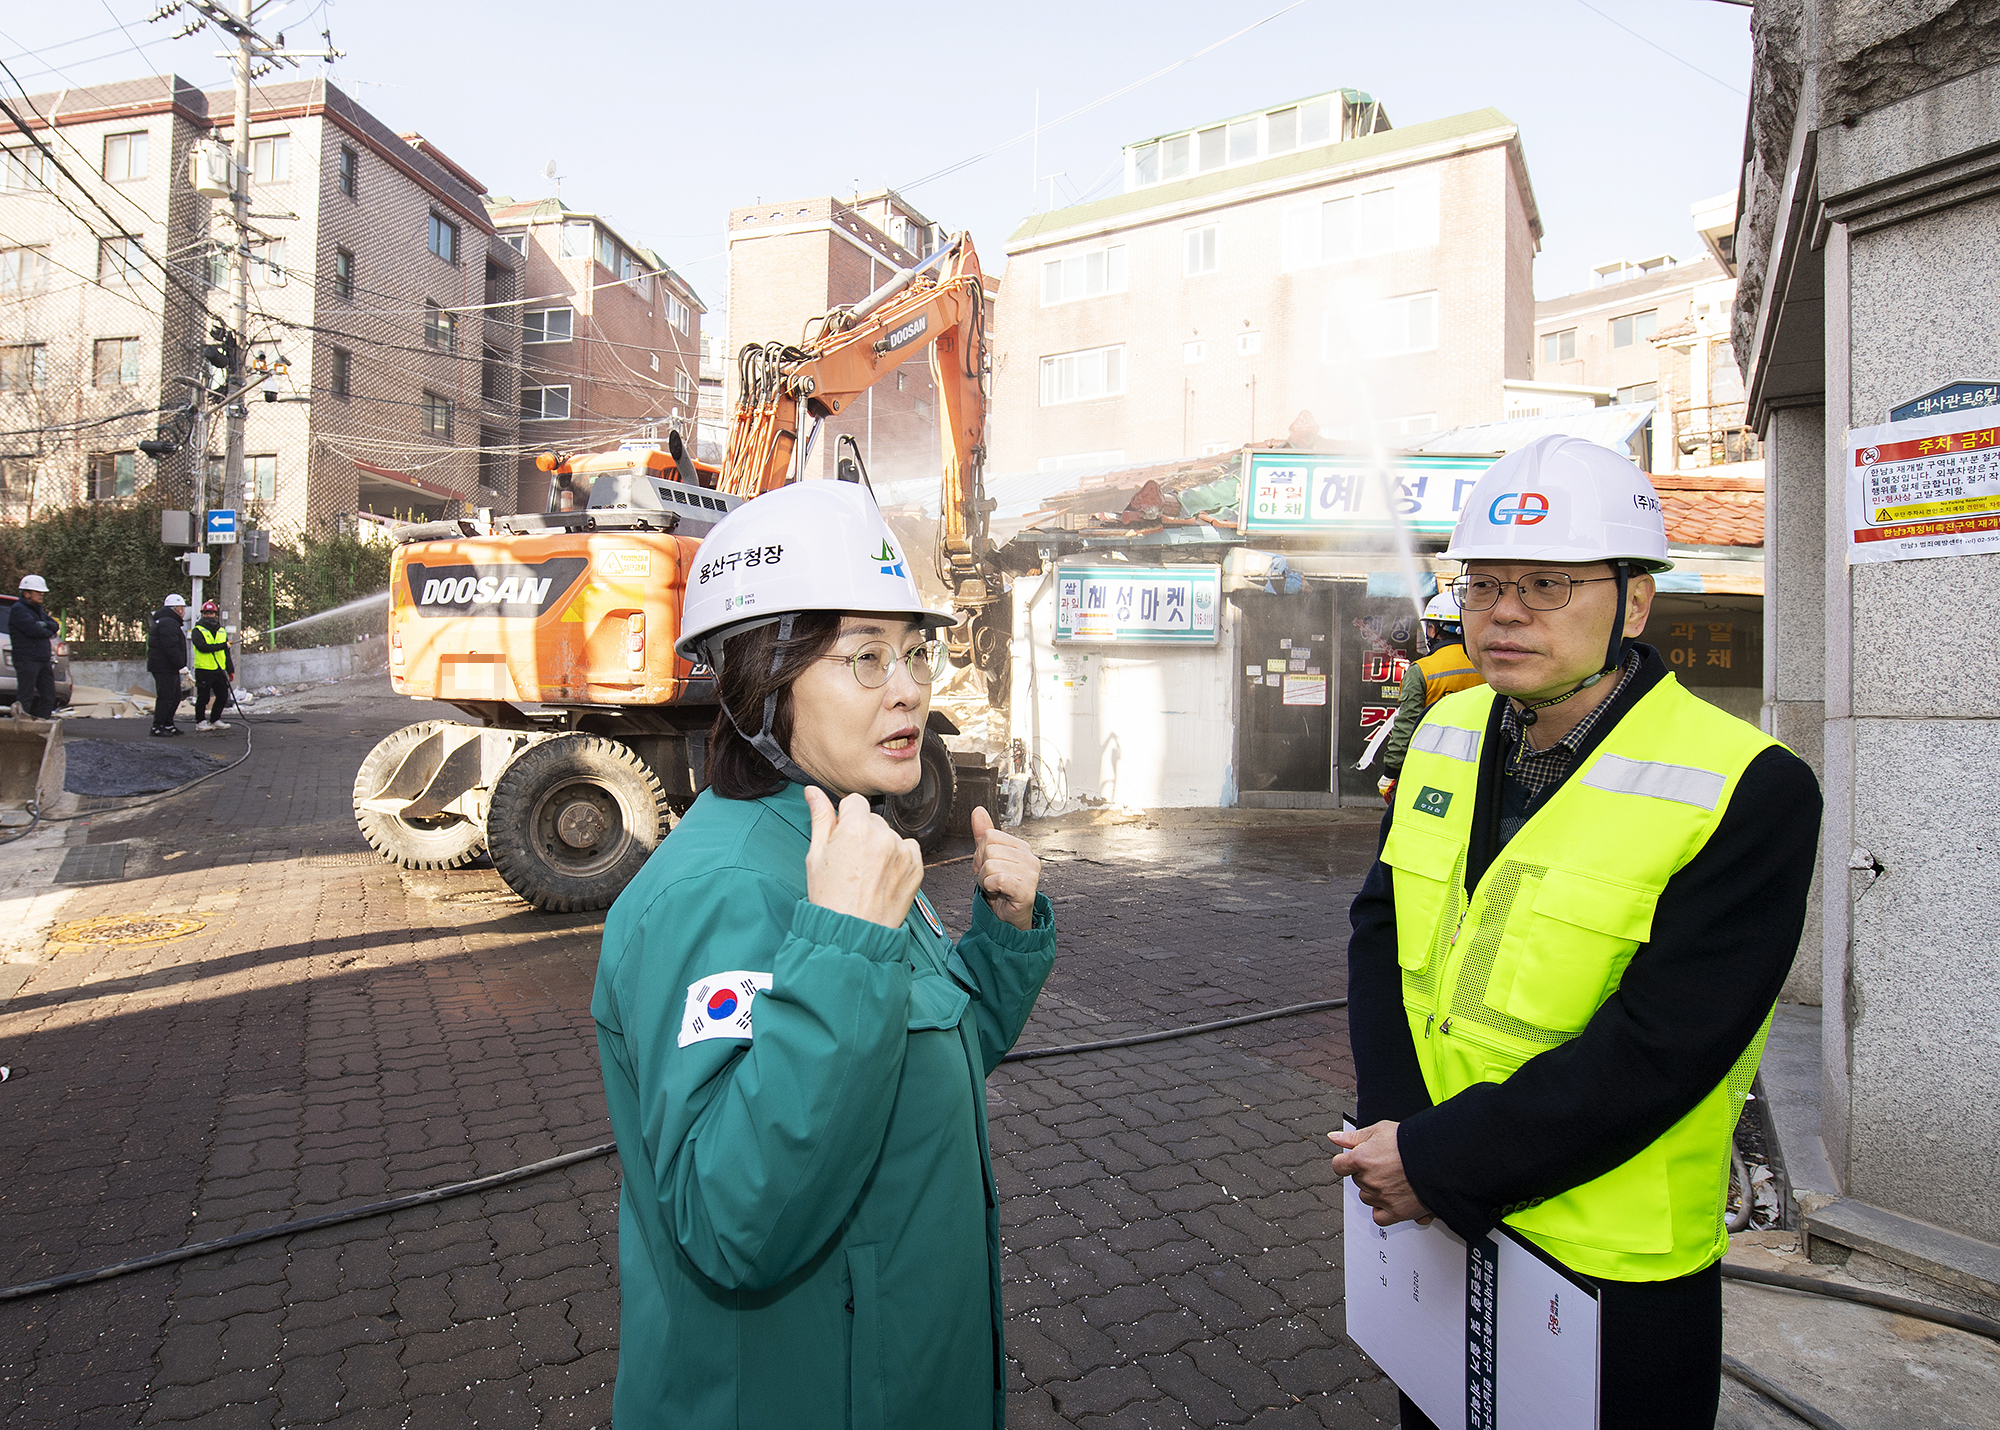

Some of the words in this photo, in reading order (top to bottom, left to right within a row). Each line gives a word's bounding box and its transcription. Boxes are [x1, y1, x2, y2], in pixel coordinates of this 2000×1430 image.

[890, 316, 926, 348] DOOSAN
[1917, 386, 1998, 412] 대사관로6길
[1918, 436, 1954, 455] 주차
[1960, 429, 1995, 450] 금지
[1269, 471, 1297, 484] 쌀
[1870, 467, 1894, 478] 한남3
[1896, 462, 1924, 474] 재개발
[1926, 457, 1956, 470] 구역내
[1881, 471, 1932, 484] 예정입니다.
[1936, 463, 1987, 478] 외부차량은
[1260, 486, 1303, 499] 과일
[1871, 484, 1898, 497] 행위를
[1900, 482, 1920, 493] 일체
[1922, 476, 1965, 489] 금합니다.
[1914, 486, 1966, 500] 고발조치함.
[1259, 502, 1303, 516] 야채
[1488, 492, 1550, 526] GD
[1978, 517, 2000, 529] 재개
[699, 544, 784, 585] 용산구청장
[421, 576, 552, 606] DOOSAN
[1064, 582, 1077, 596] 쌀
[1061, 598, 1080, 610] 과일
[1670, 621, 1732, 642] 과일
[1669, 647, 1732, 669] 야채
[1412, 1269, 1420, 1303] 2025년
[1471, 1247, 1482, 1314] 이주현황
[1470, 1317, 1481, 1337] 및
[1483, 1260, 1494, 1375] 한남재정비촉진지구
[1469, 1340, 1482, 1376] 철거
